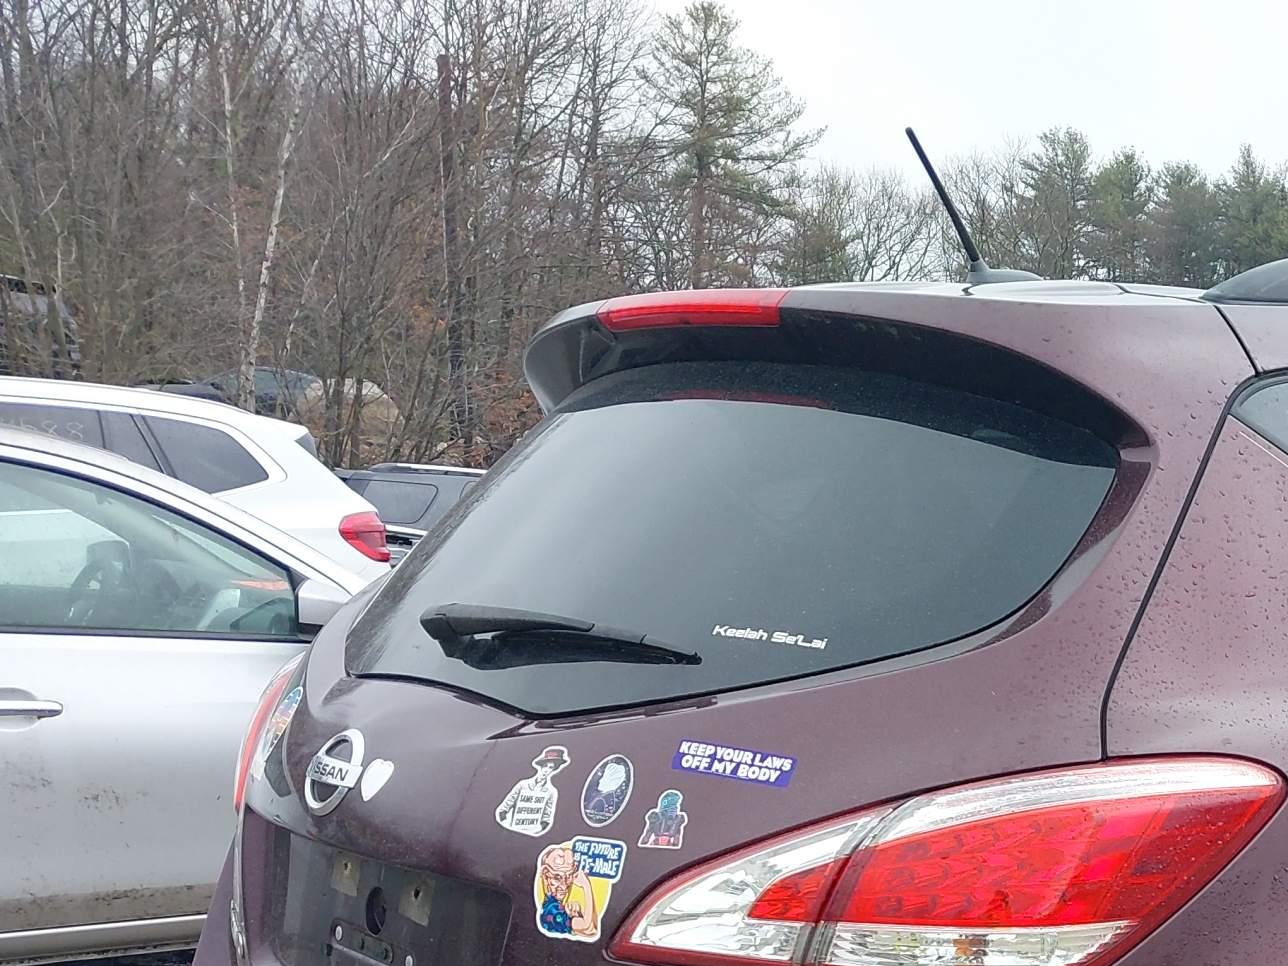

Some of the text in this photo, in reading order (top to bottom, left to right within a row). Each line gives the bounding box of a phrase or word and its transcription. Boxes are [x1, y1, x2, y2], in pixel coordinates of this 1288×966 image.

[712, 624, 768, 641] Keelah
[679, 741, 793, 771] KEEP YOUR LAWS
[681, 754, 780, 782] OFF MY BODY
[575, 841, 621, 860] THE FUTURE
